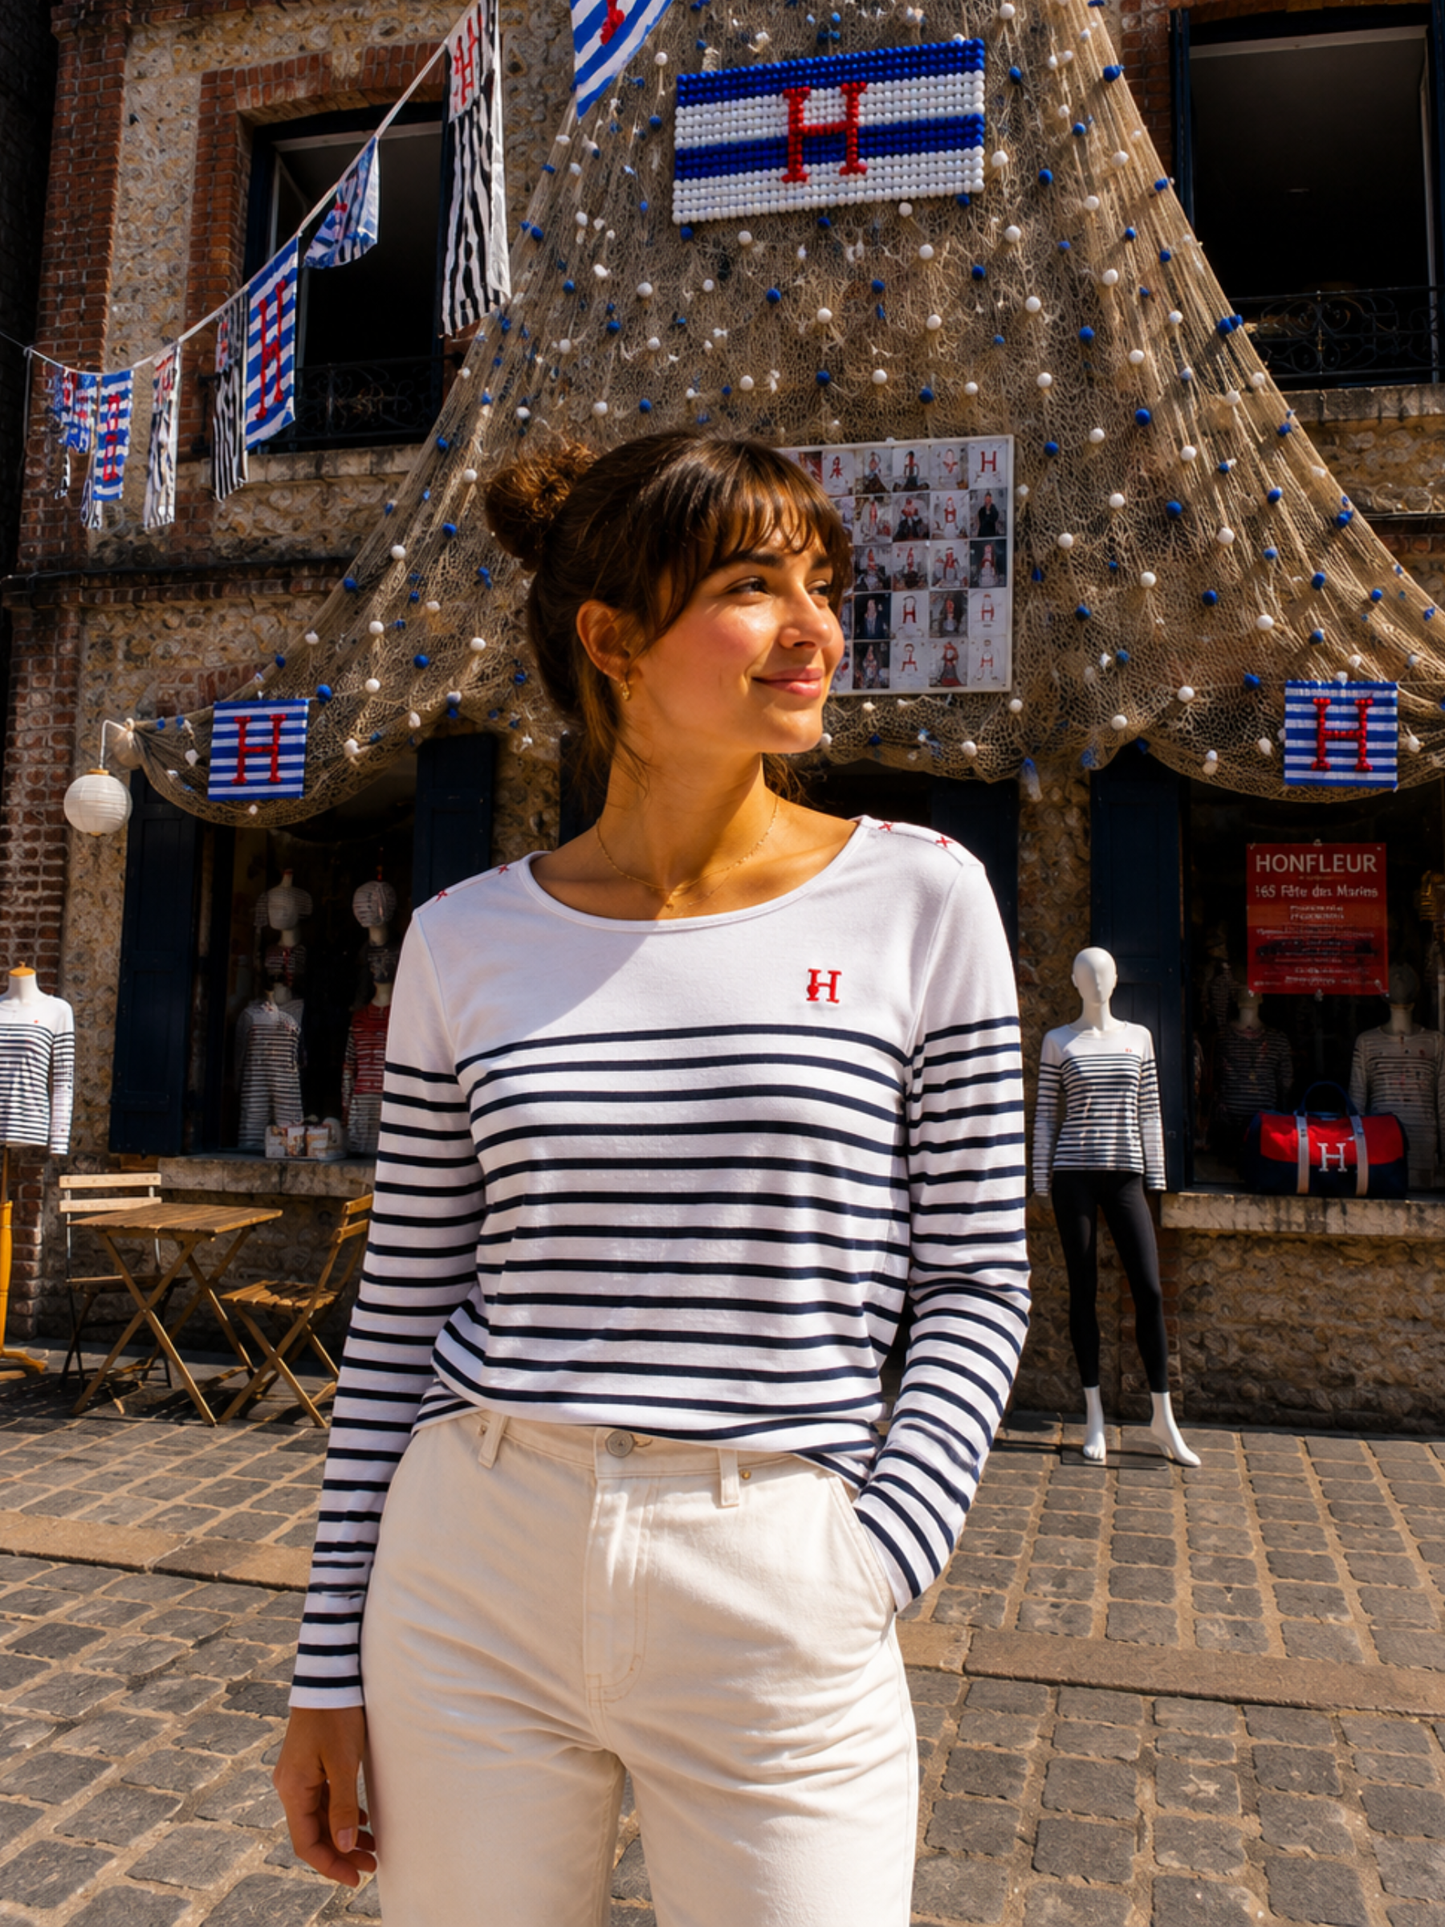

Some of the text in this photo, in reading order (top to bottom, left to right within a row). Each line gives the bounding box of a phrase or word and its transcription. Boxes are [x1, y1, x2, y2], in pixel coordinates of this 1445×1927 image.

[781, 81, 868, 184] H
[256, 279, 287, 422] H
[980, 450, 997, 472] H
[231, 713, 287, 785] H
[1311, 697, 1374, 772] H
[1255, 853, 1378, 873] HONFLEUR
[806, 968, 842, 1004] H
[1317, 1142, 1348, 1173] H
